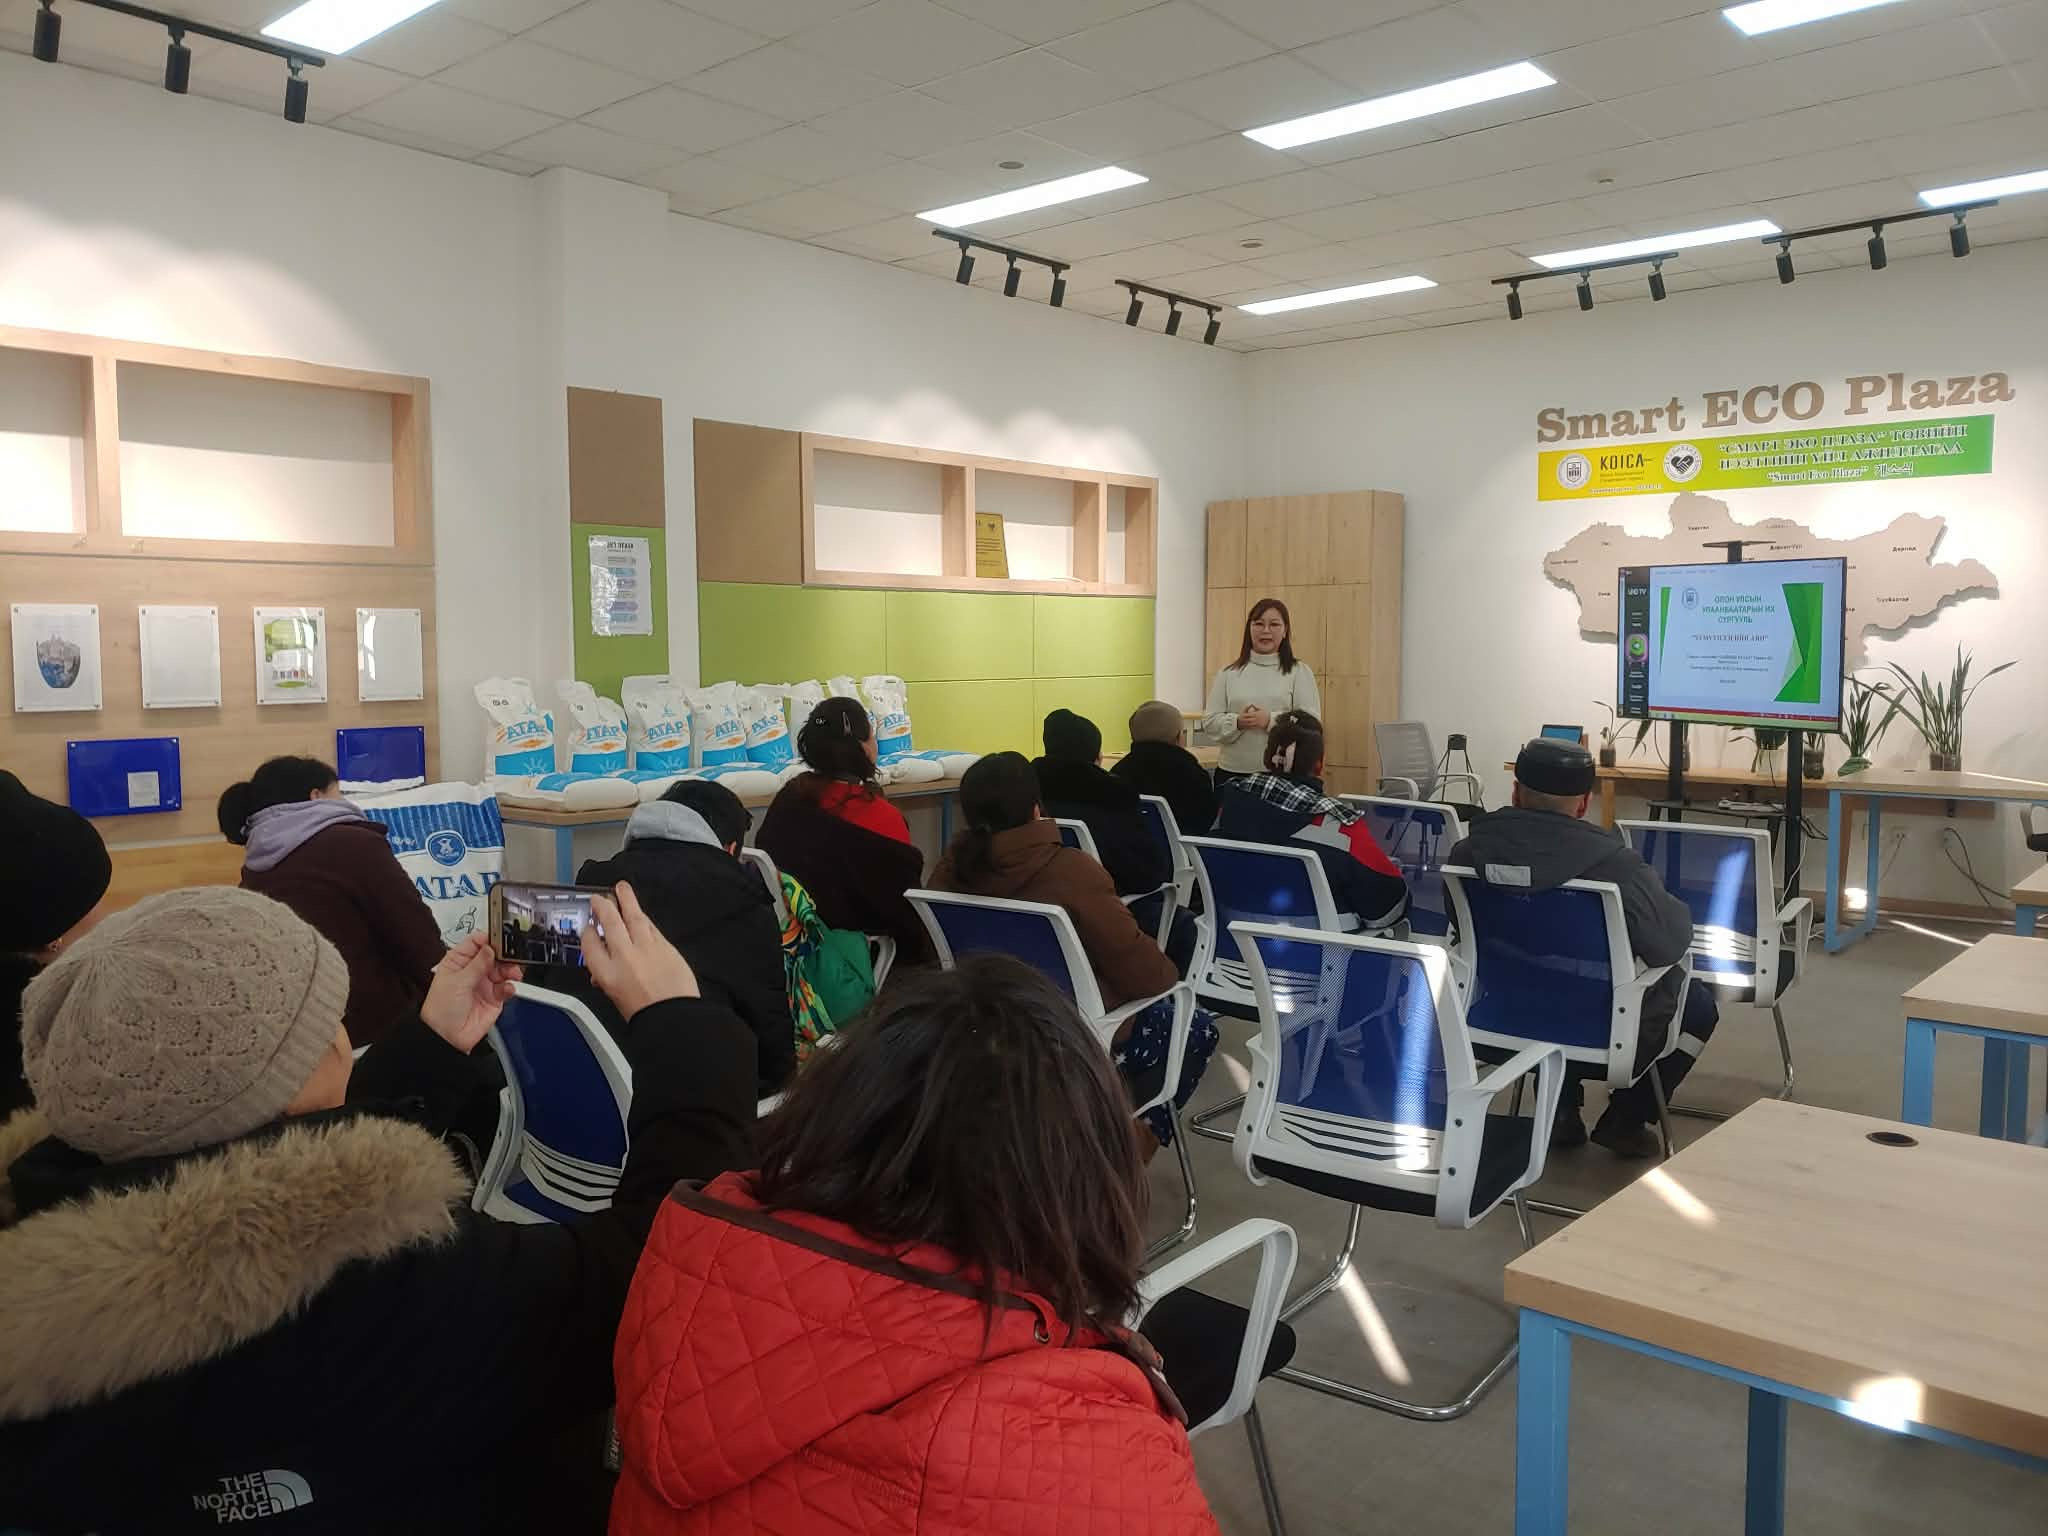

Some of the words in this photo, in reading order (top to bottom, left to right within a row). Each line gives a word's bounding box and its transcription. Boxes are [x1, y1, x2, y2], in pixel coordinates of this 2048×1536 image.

[1537, 396, 1686, 443] Smart
[1702, 381, 1825, 428] ECO
[1844, 371, 2016, 415] Plaza
[1787, 438, 1817, 450] ЭКО
[1600, 453, 1645, 471] KOICA
[217, 1471, 264, 1492] THE
[192, 1486, 268, 1511] NORTH
[216, 1500, 272, 1525] FACE
